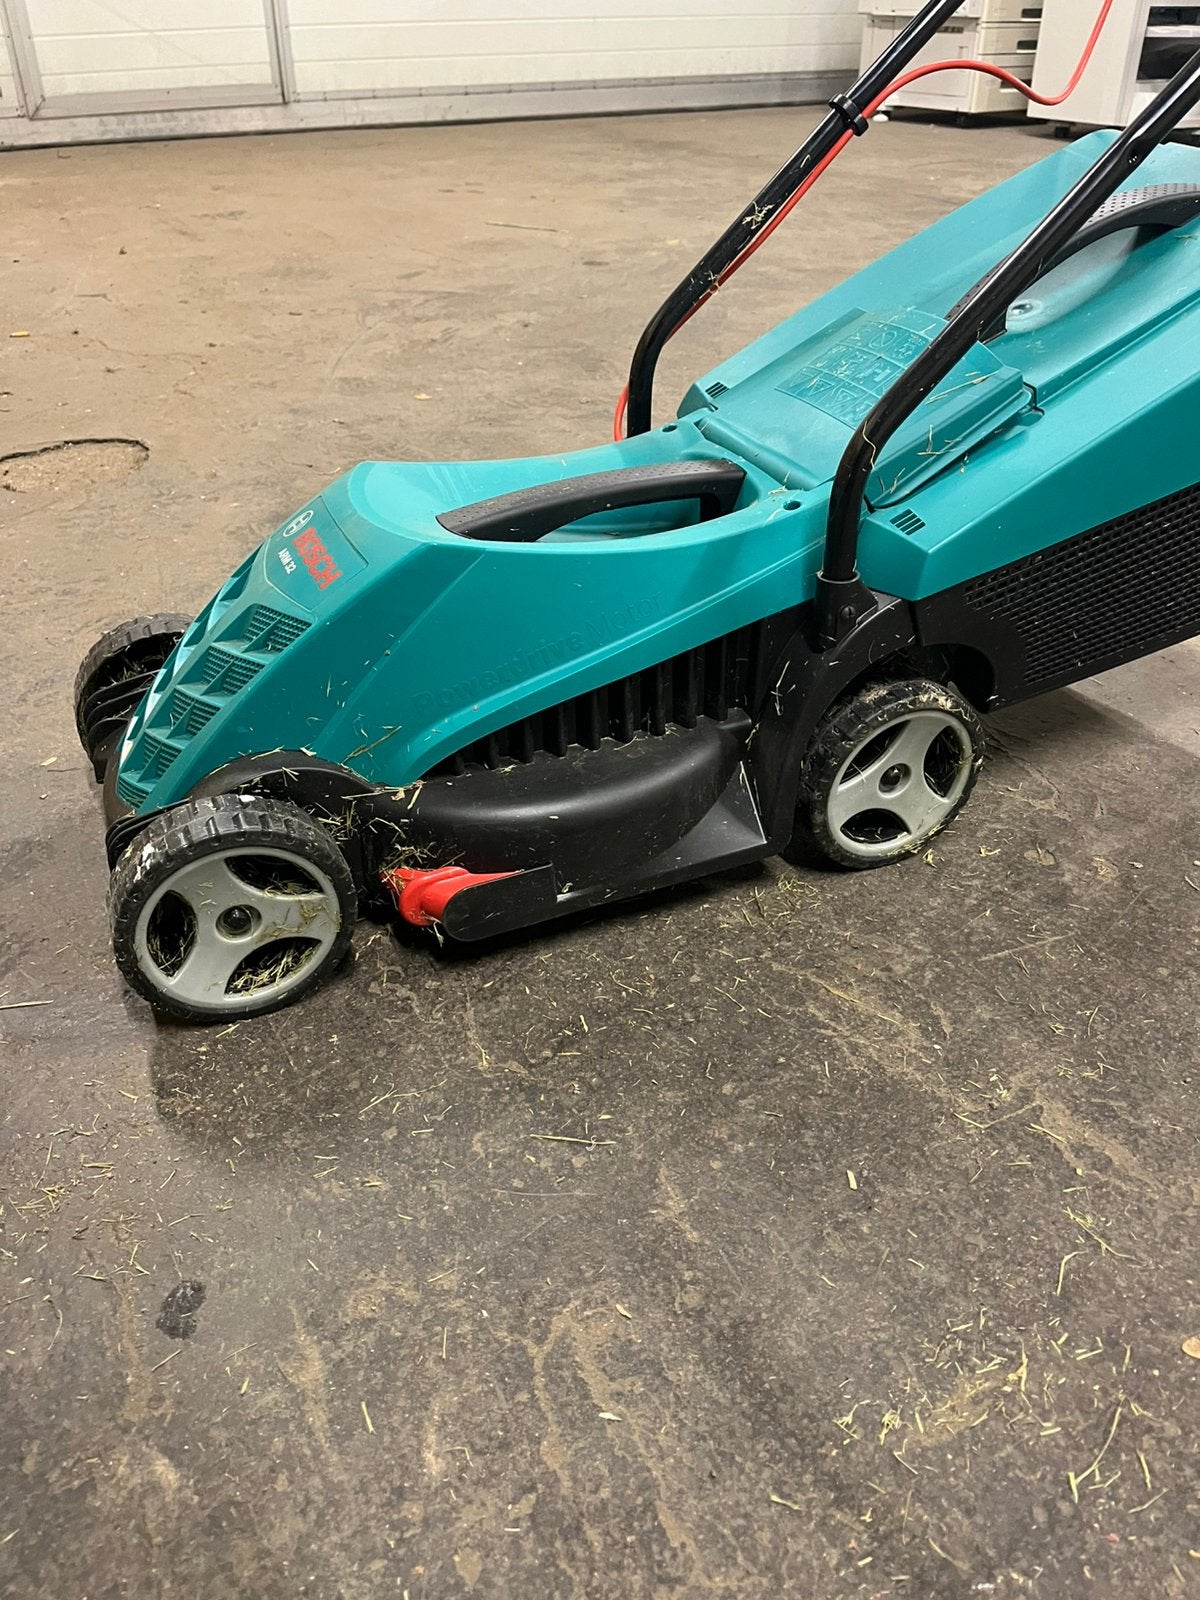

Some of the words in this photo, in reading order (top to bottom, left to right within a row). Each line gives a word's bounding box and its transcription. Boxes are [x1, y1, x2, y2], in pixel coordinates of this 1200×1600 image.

[278, 548, 292, 567] ARM
[294, 528, 342, 590] BOSCH
[284, 561, 296, 574] 32
